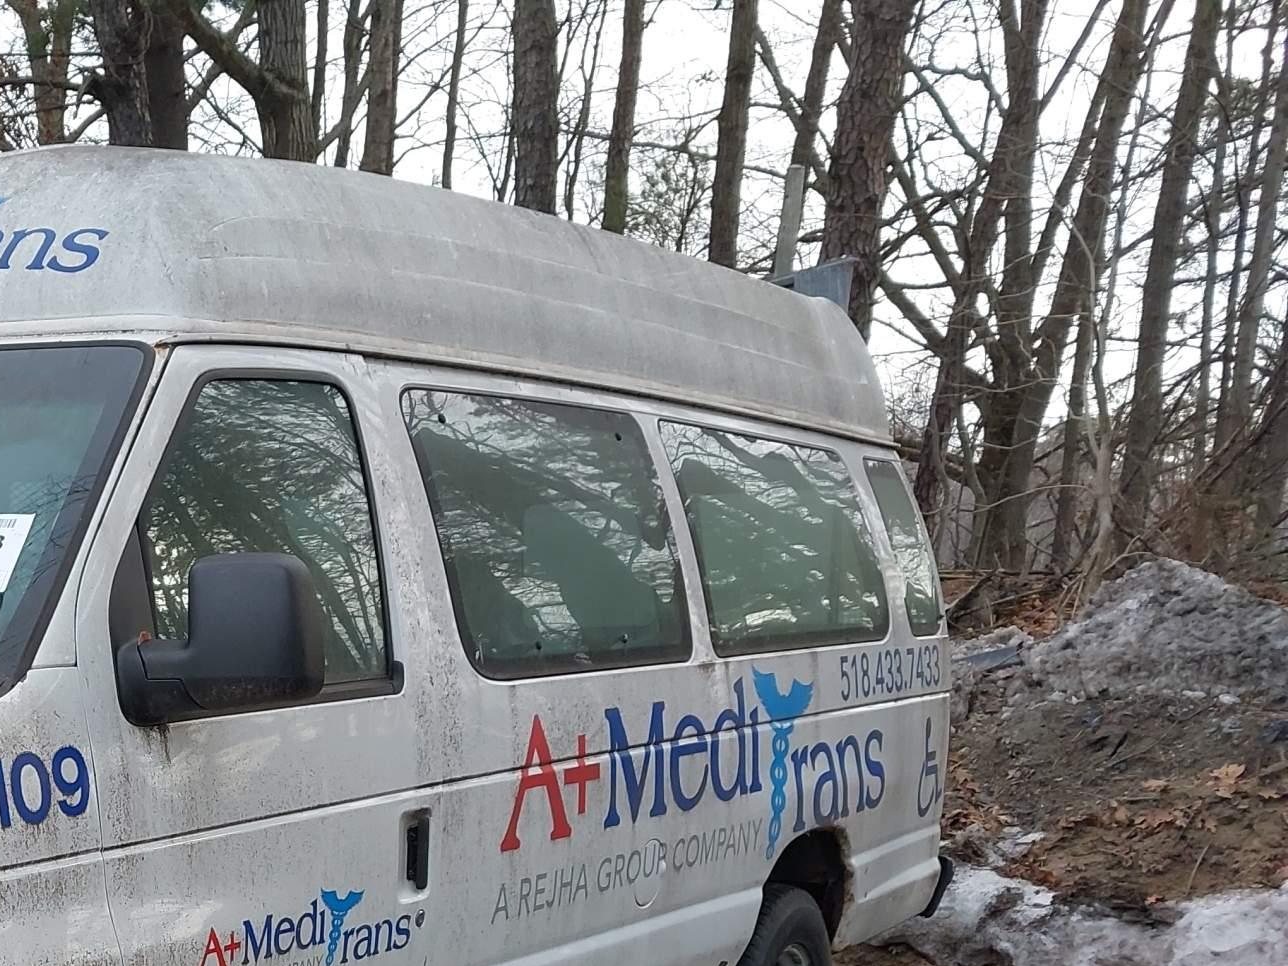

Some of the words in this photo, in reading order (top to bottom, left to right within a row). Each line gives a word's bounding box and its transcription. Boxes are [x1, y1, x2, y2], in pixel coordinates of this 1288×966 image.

[840, 645, 940, 701] 518.433.7433
[491, 883, 509, 925] A
[518, 864, 589, 917] REJHA
[597, 842, 668, 893] GROUP
[673, 819, 762, 872] COMPANY
